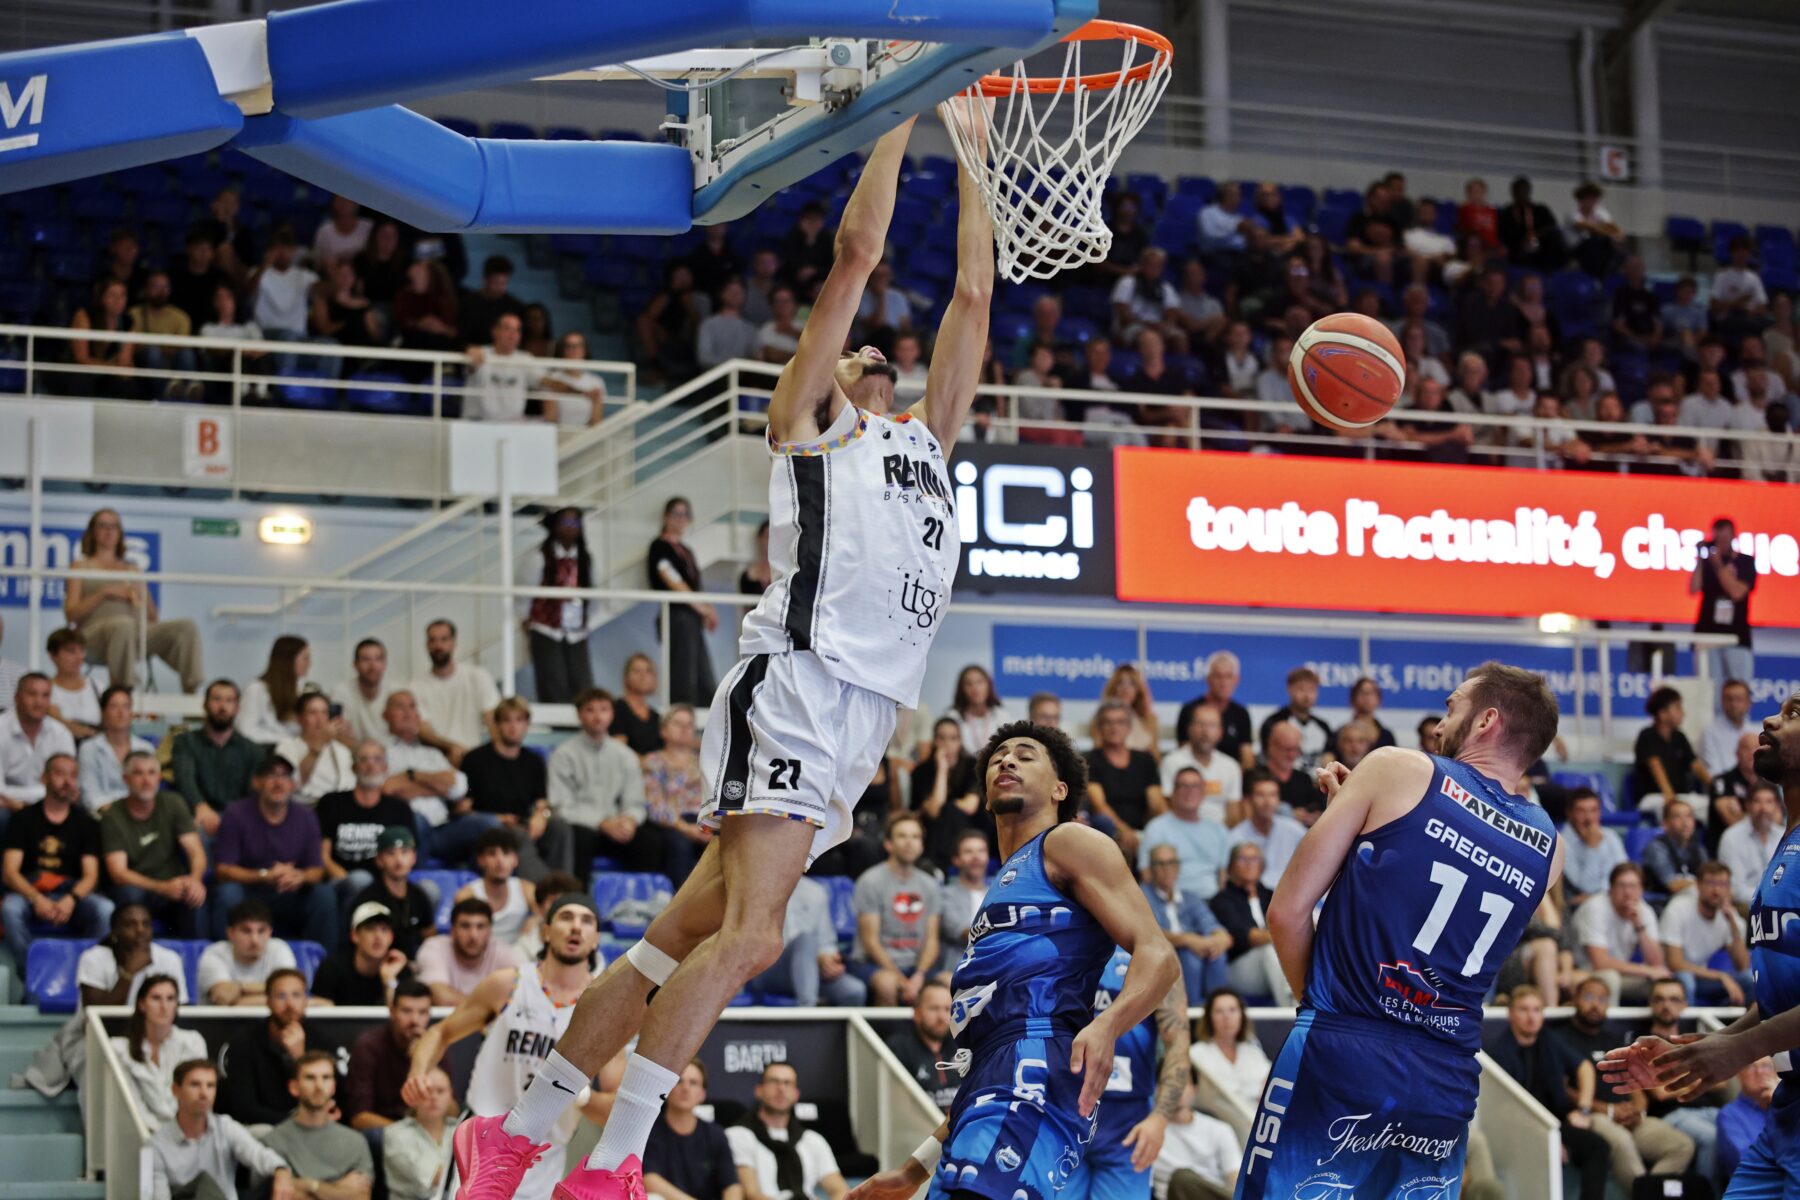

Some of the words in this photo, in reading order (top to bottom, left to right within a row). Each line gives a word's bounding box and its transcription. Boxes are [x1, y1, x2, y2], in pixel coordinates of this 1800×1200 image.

[199, 420, 219, 455] B
[1186, 496, 1339, 556] toute
[1345, 498, 1616, 578] l'actualité,
[1444, 777, 1551, 856] MAYENNE
[1424, 818, 1535, 898] GREGOIRE
[1413, 861, 1514, 978] 11
[1246, 1077, 1294, 1175] USL
